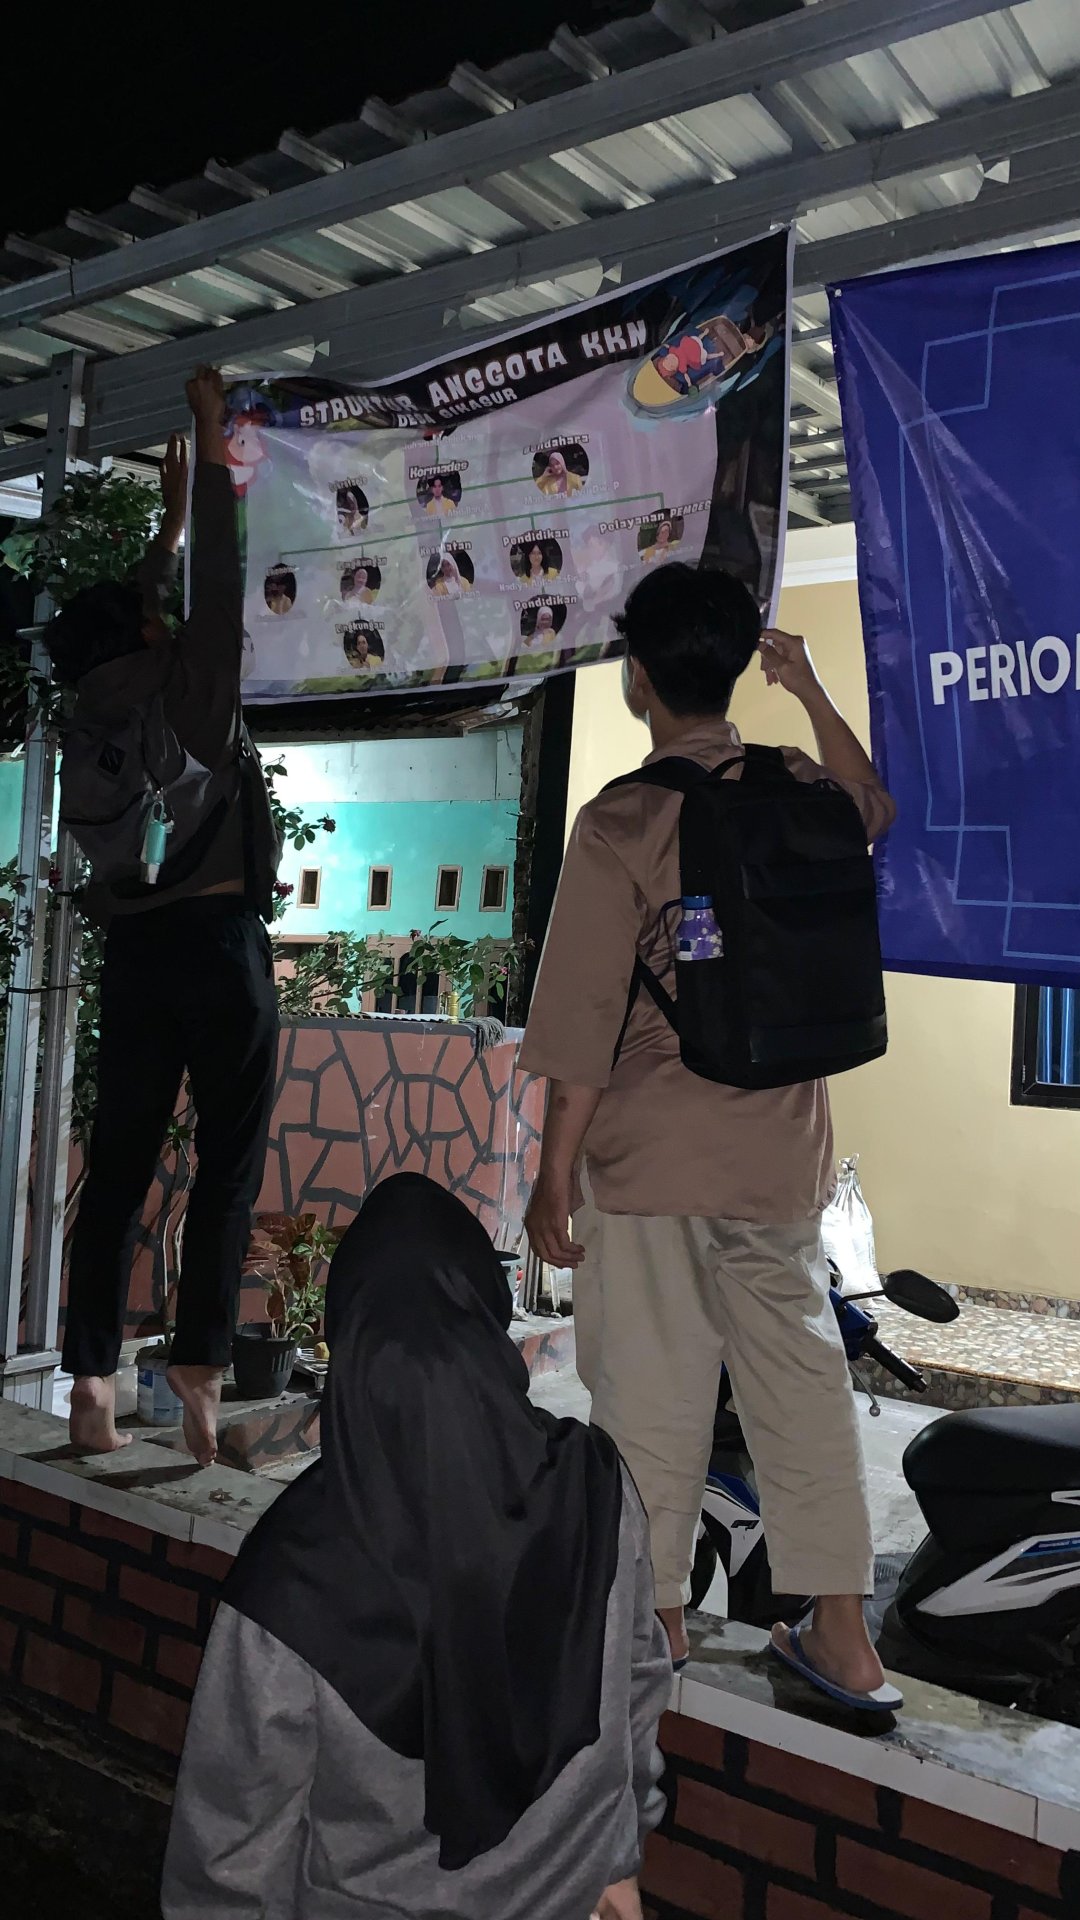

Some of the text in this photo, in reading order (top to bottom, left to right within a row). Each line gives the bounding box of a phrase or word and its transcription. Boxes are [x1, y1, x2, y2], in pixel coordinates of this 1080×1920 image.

[300, 319, 647, 428] STRUKTUR ANGGOTA KKN
[397, 387, 518, 428] DESA SIKASUR
[600, 512, 665, 535] Pelayanan
[420, 541, 472, 557] Keseatan
[503, 530, 569, 546] Pendidikan
[515, 596, 577, 611] Pendidikan
[930, 633, 1080, 705] PERIO
